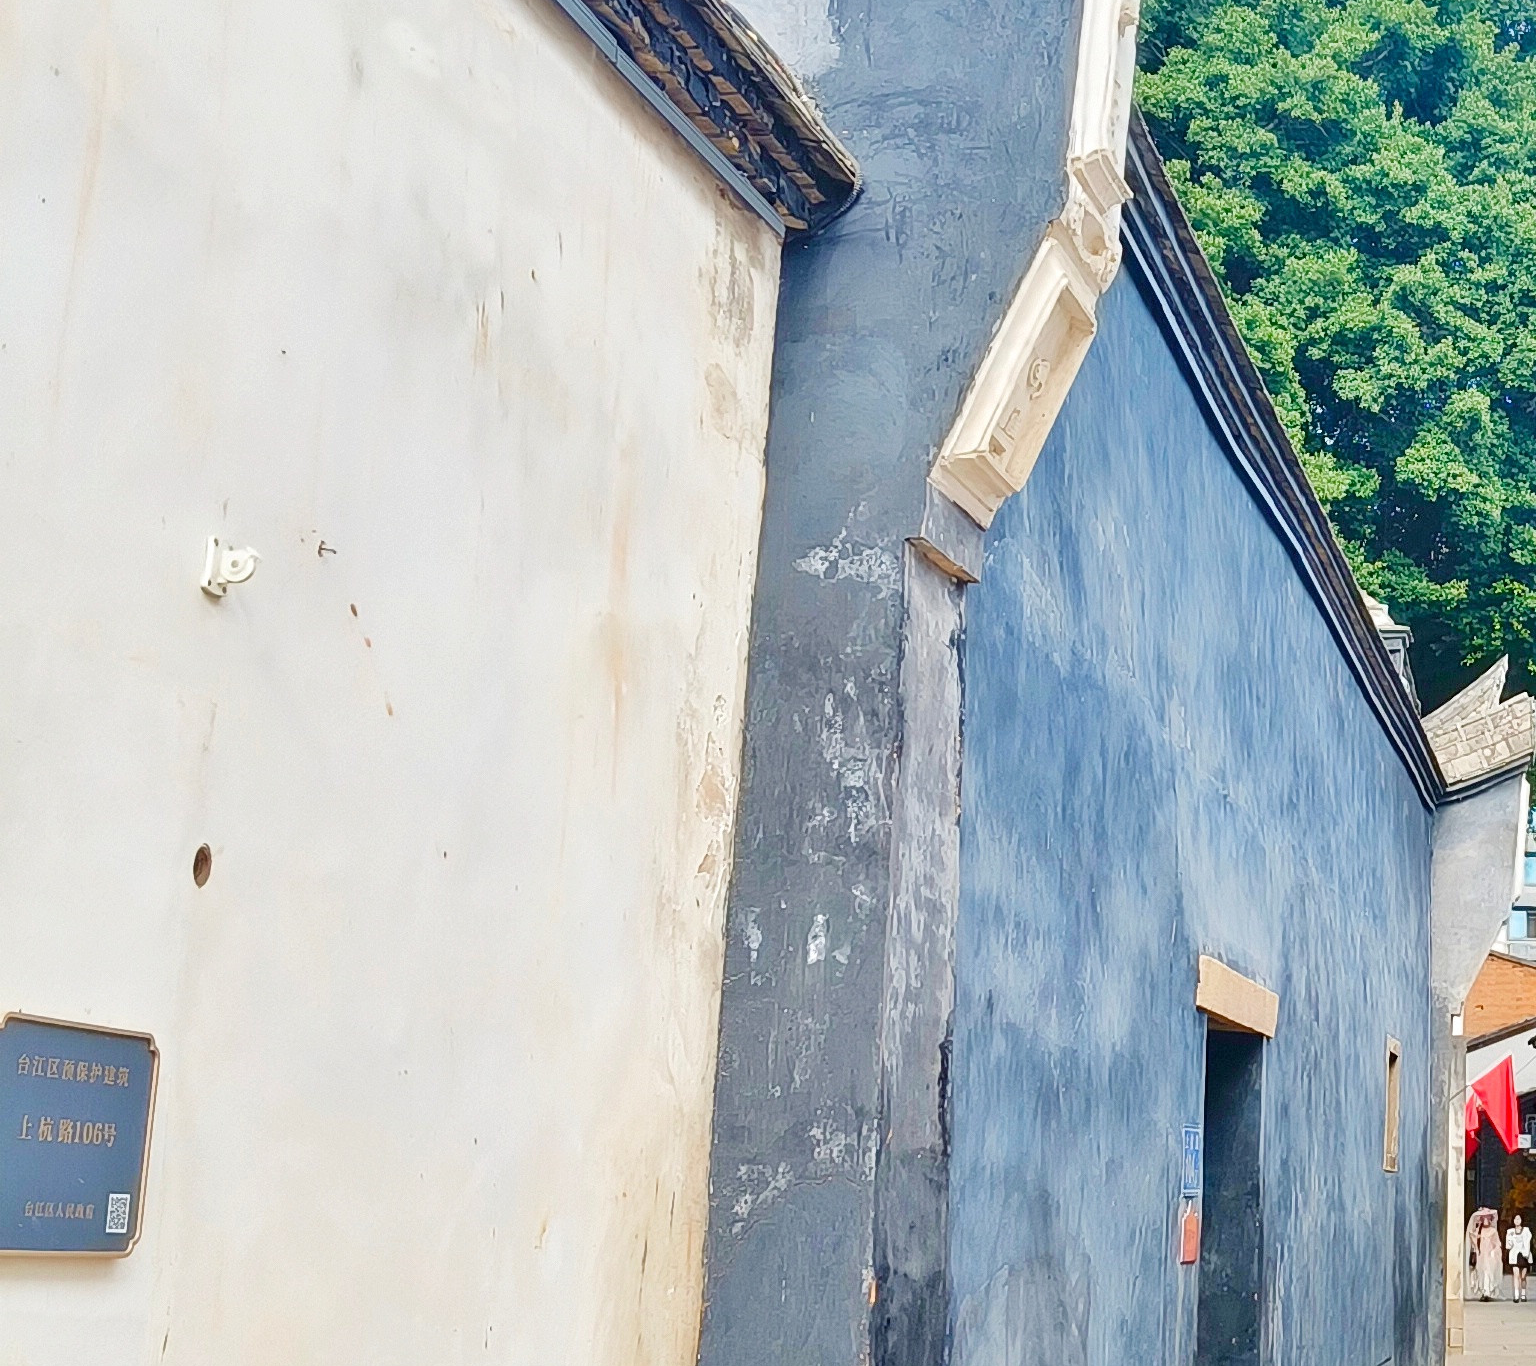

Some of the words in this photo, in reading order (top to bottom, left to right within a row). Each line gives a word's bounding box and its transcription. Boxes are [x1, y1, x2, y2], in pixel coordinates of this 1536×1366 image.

[17, 1053, 130, 1087] 台江区预保护建筑
[17, 1114, 117, 1148] 上杭路106号
